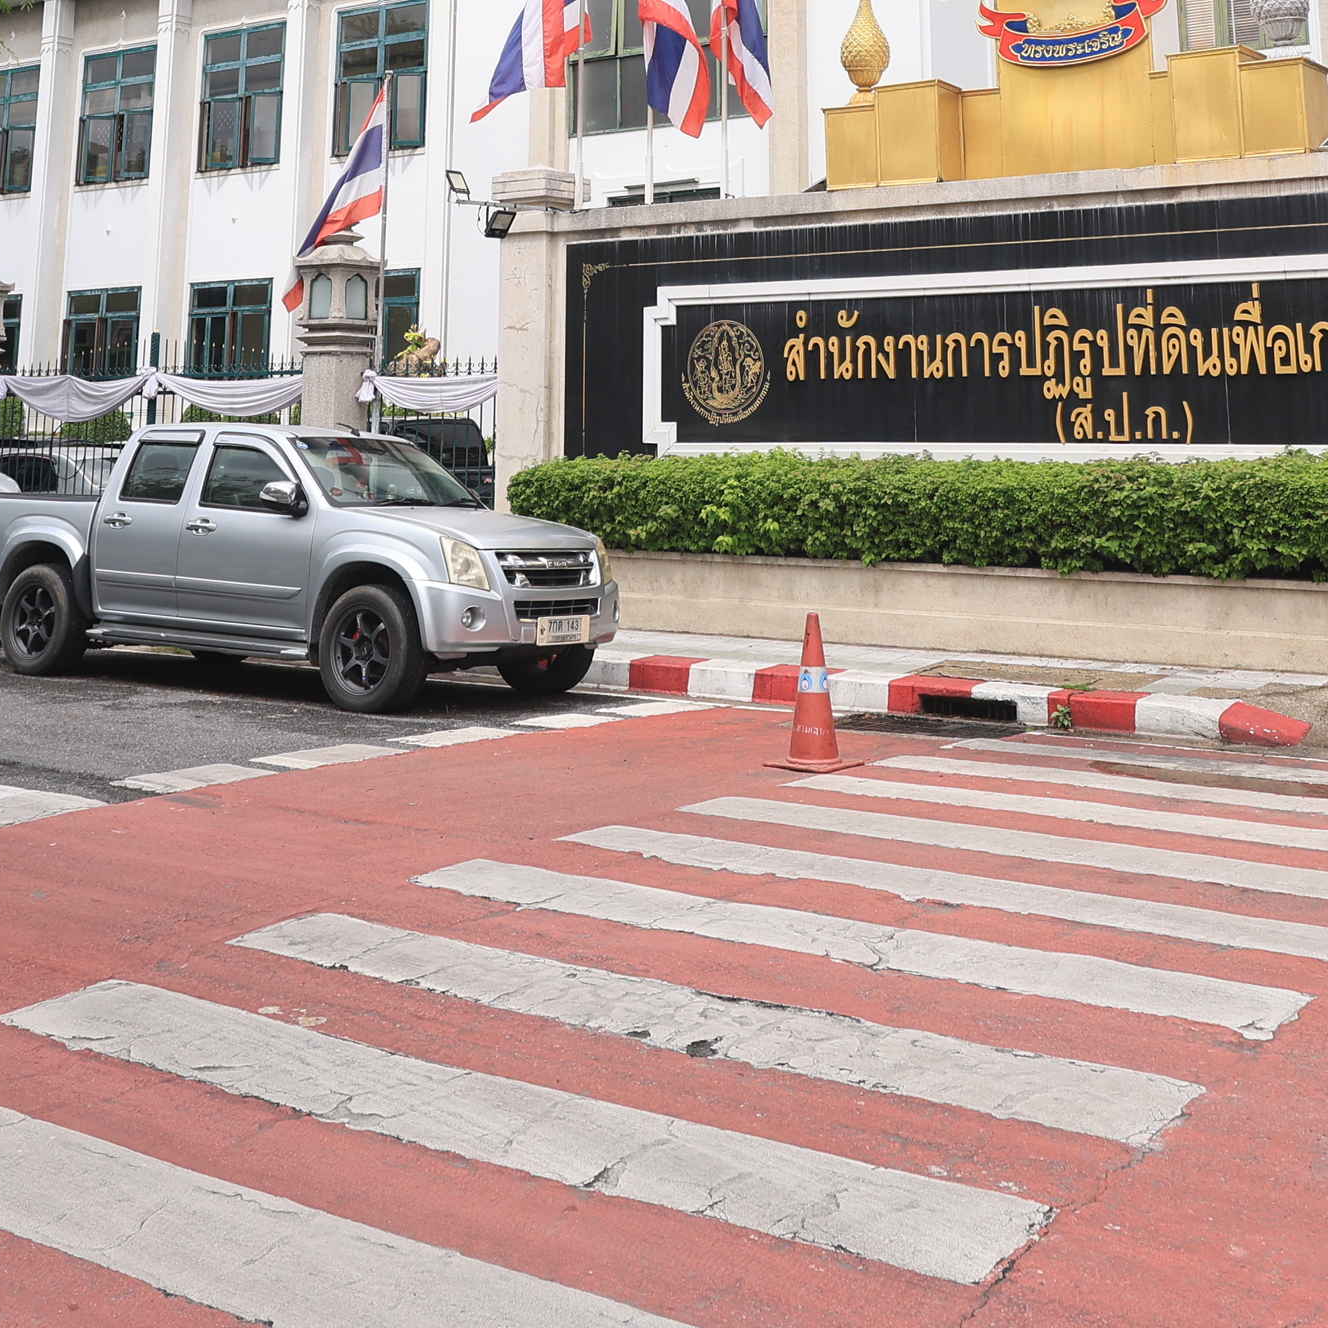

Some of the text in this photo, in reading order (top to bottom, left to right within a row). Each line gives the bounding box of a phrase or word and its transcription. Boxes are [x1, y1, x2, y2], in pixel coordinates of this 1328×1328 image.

[1022, 30, 1123, 59] ทรงพระเจริญ
[1054, 391, 1193, 445] (ส.ป.ก.)
[567, 620, 579, 632] 143
